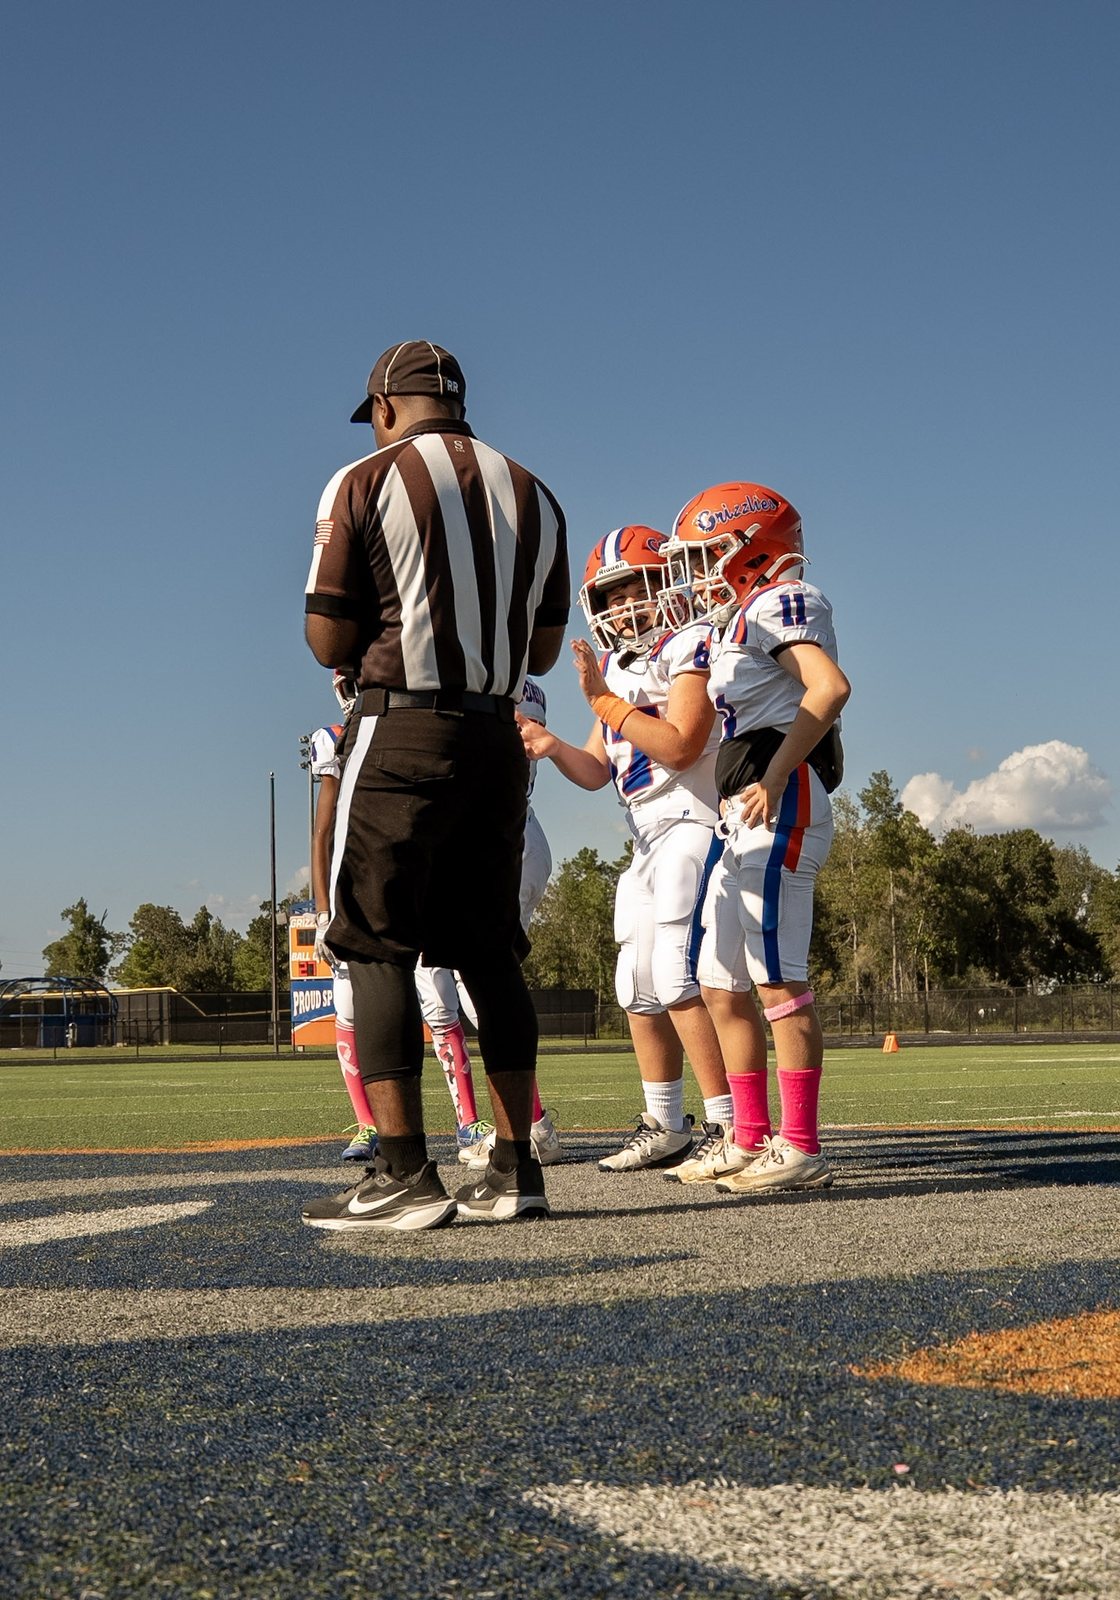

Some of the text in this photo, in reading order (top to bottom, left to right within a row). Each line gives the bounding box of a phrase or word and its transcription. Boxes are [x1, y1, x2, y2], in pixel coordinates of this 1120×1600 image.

[697, 495, 776, 534] Grizzlies
[779, 592, 808, 627] 11
[290, 918, 317, 928] GRIZZ
[292, 951, 310, 961] BALL
[293, 989, 334, 1017] PROUD SP
